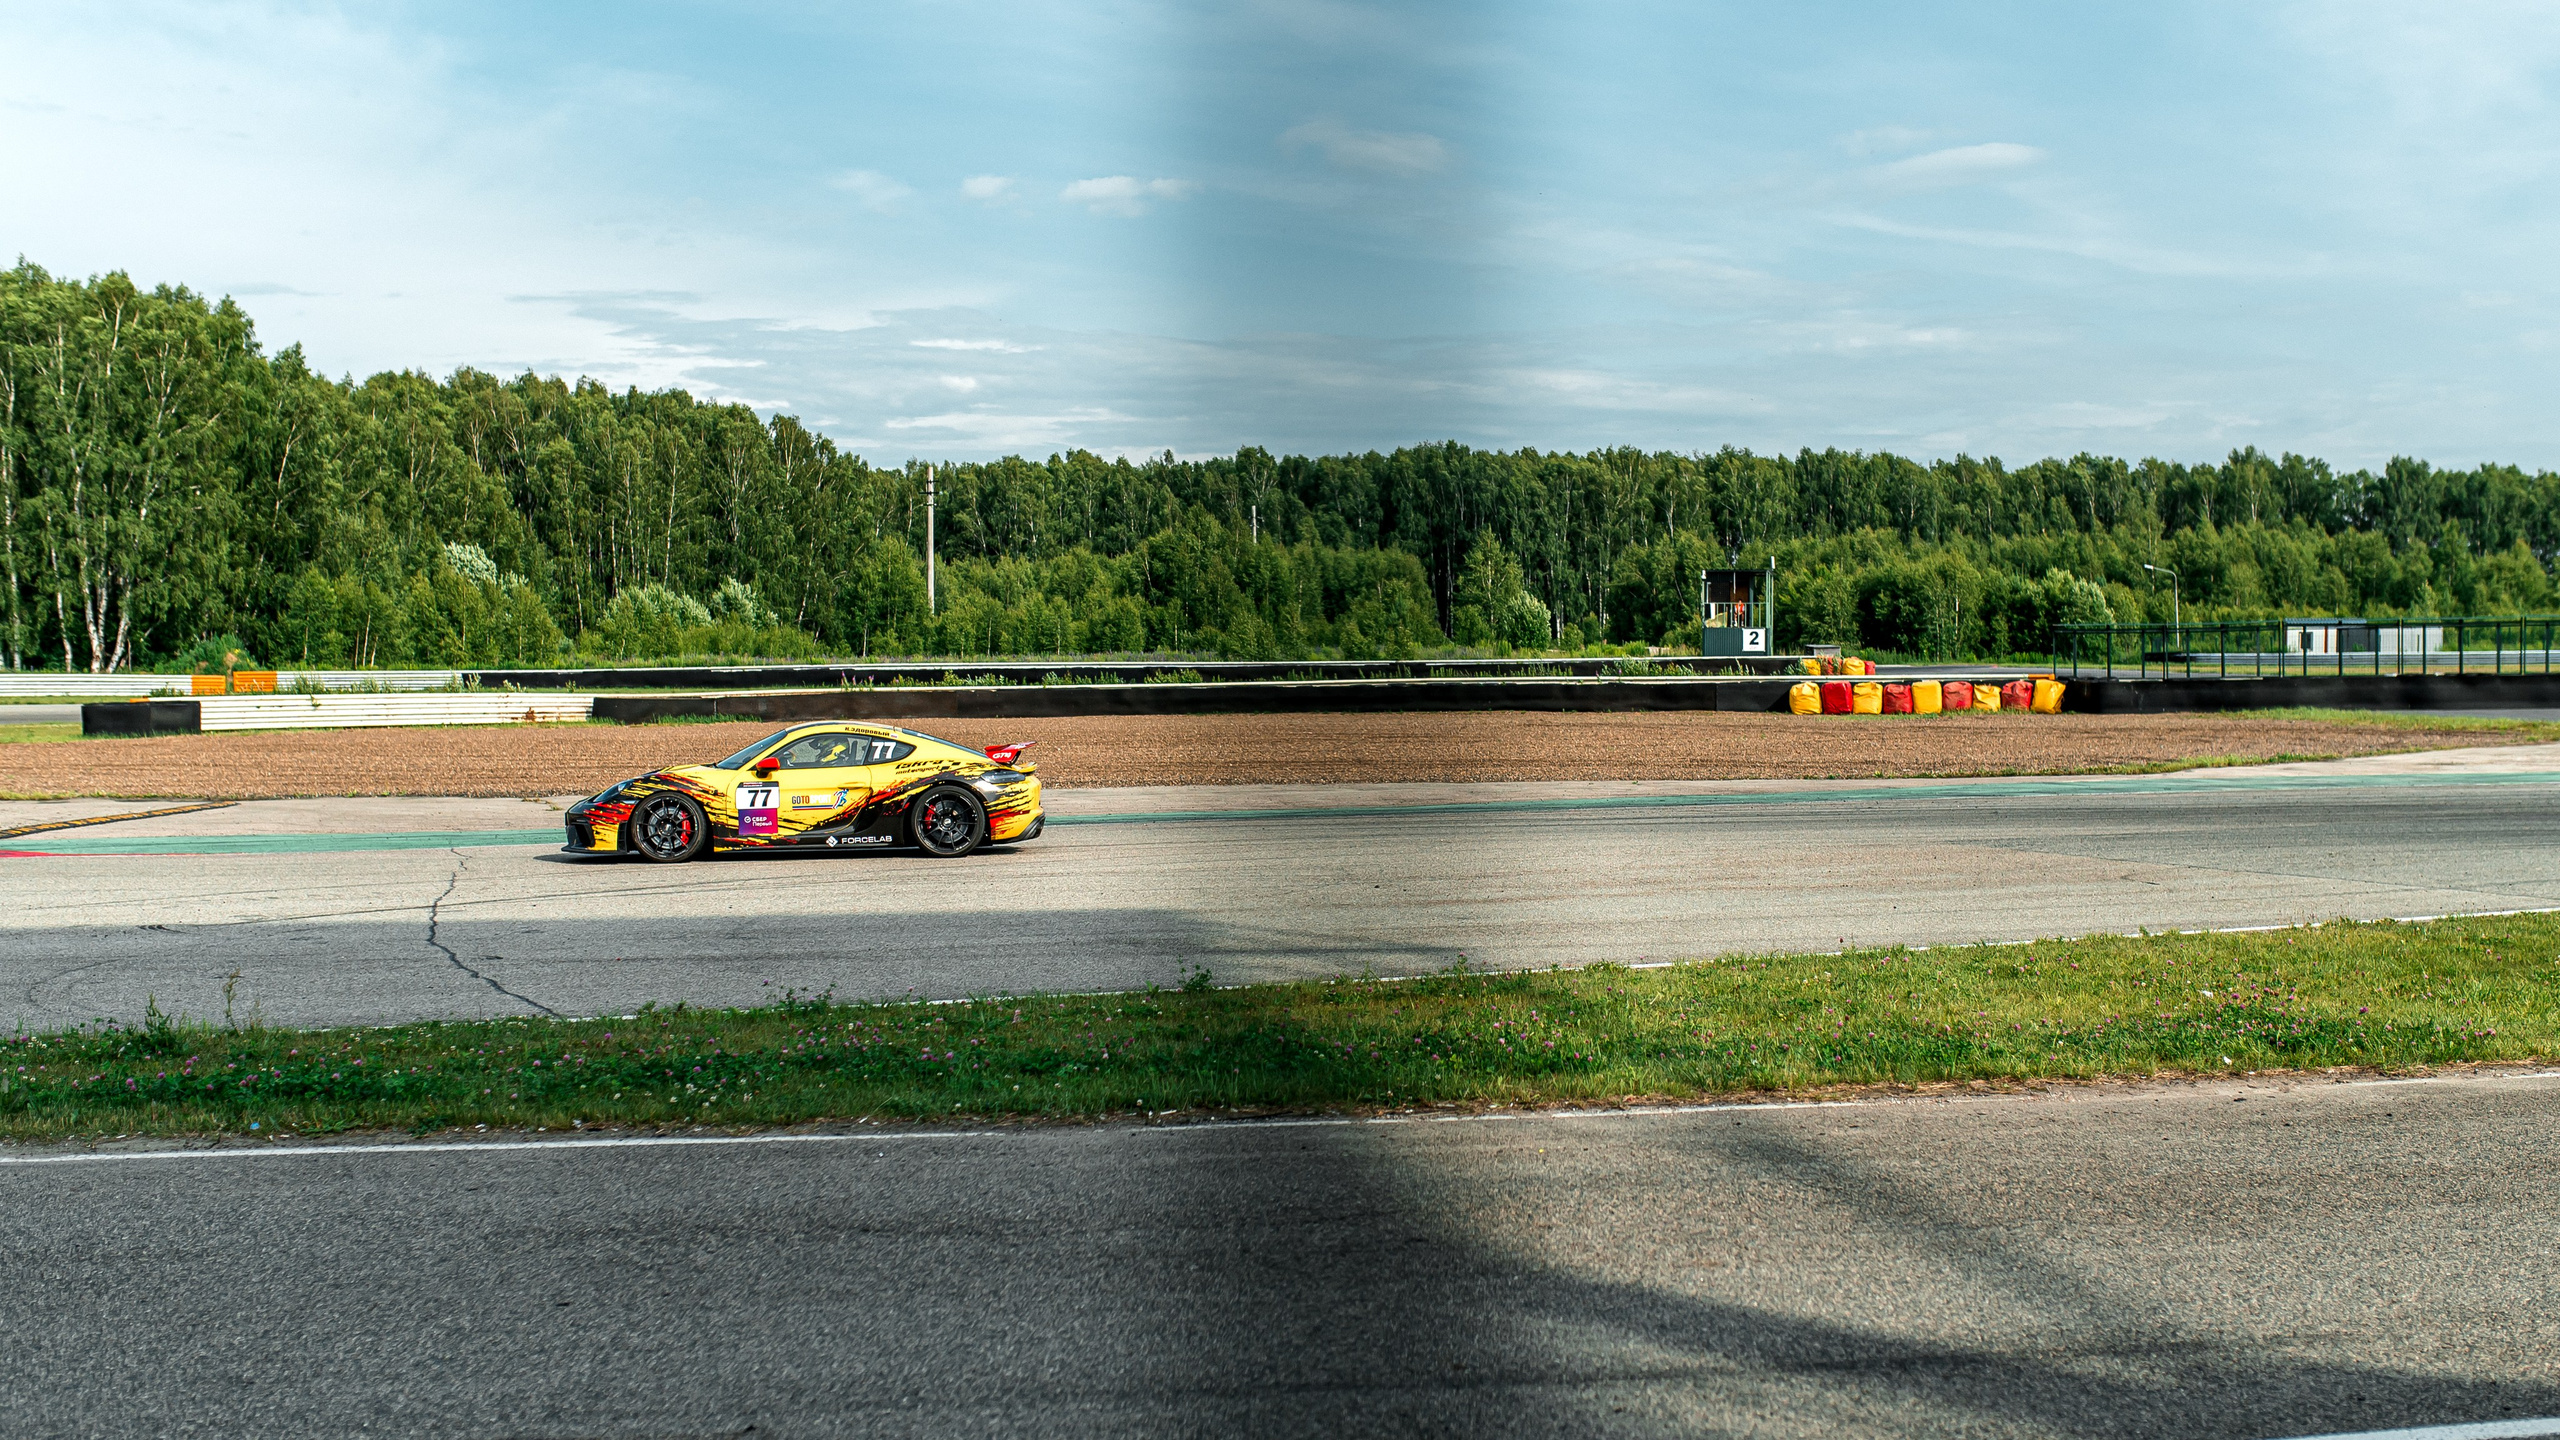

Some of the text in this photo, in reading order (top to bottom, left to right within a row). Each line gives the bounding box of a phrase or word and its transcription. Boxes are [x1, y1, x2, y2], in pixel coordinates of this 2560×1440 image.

[1749, 631, 1759, 645] 2
[872, 742, 896, 760] 77
[748, 789, 772, 807] 77
[841, 835, 893, 844] FORCELAB
